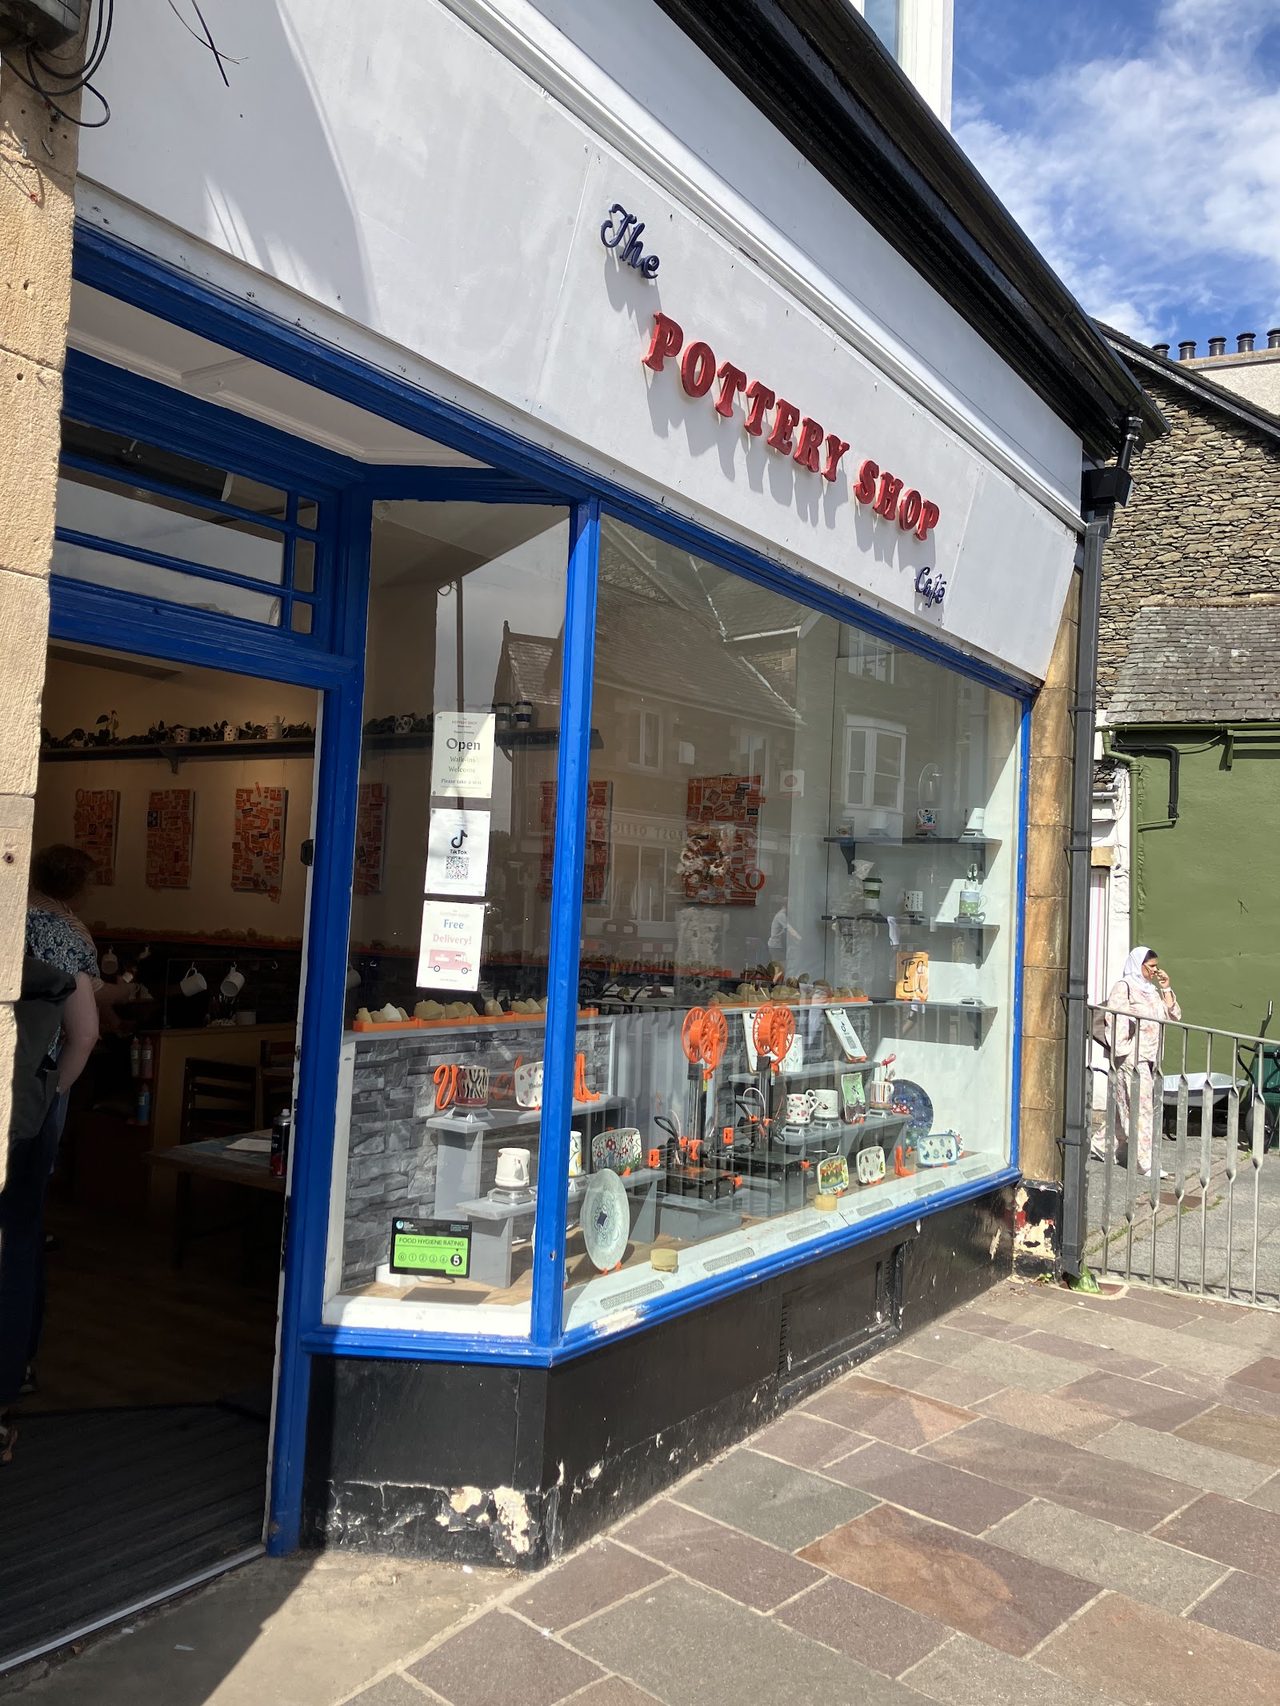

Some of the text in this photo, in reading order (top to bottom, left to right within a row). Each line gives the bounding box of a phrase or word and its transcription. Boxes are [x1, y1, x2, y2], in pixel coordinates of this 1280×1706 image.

[601, 203, 660, 279] The
[642, 311, 940, 541] POTTERY SHOP
[914, 566, 947, 608] Café
[446, 737, 481, 752] Open
[443, 919, 465, 929] Free
[432, 934, 472, 946] Delivery!
[417, 1238, 443, 1246] HYGIENE
[443, 1239, 465, 1247] RATING
[453, 1255, 460, 1266] 5
